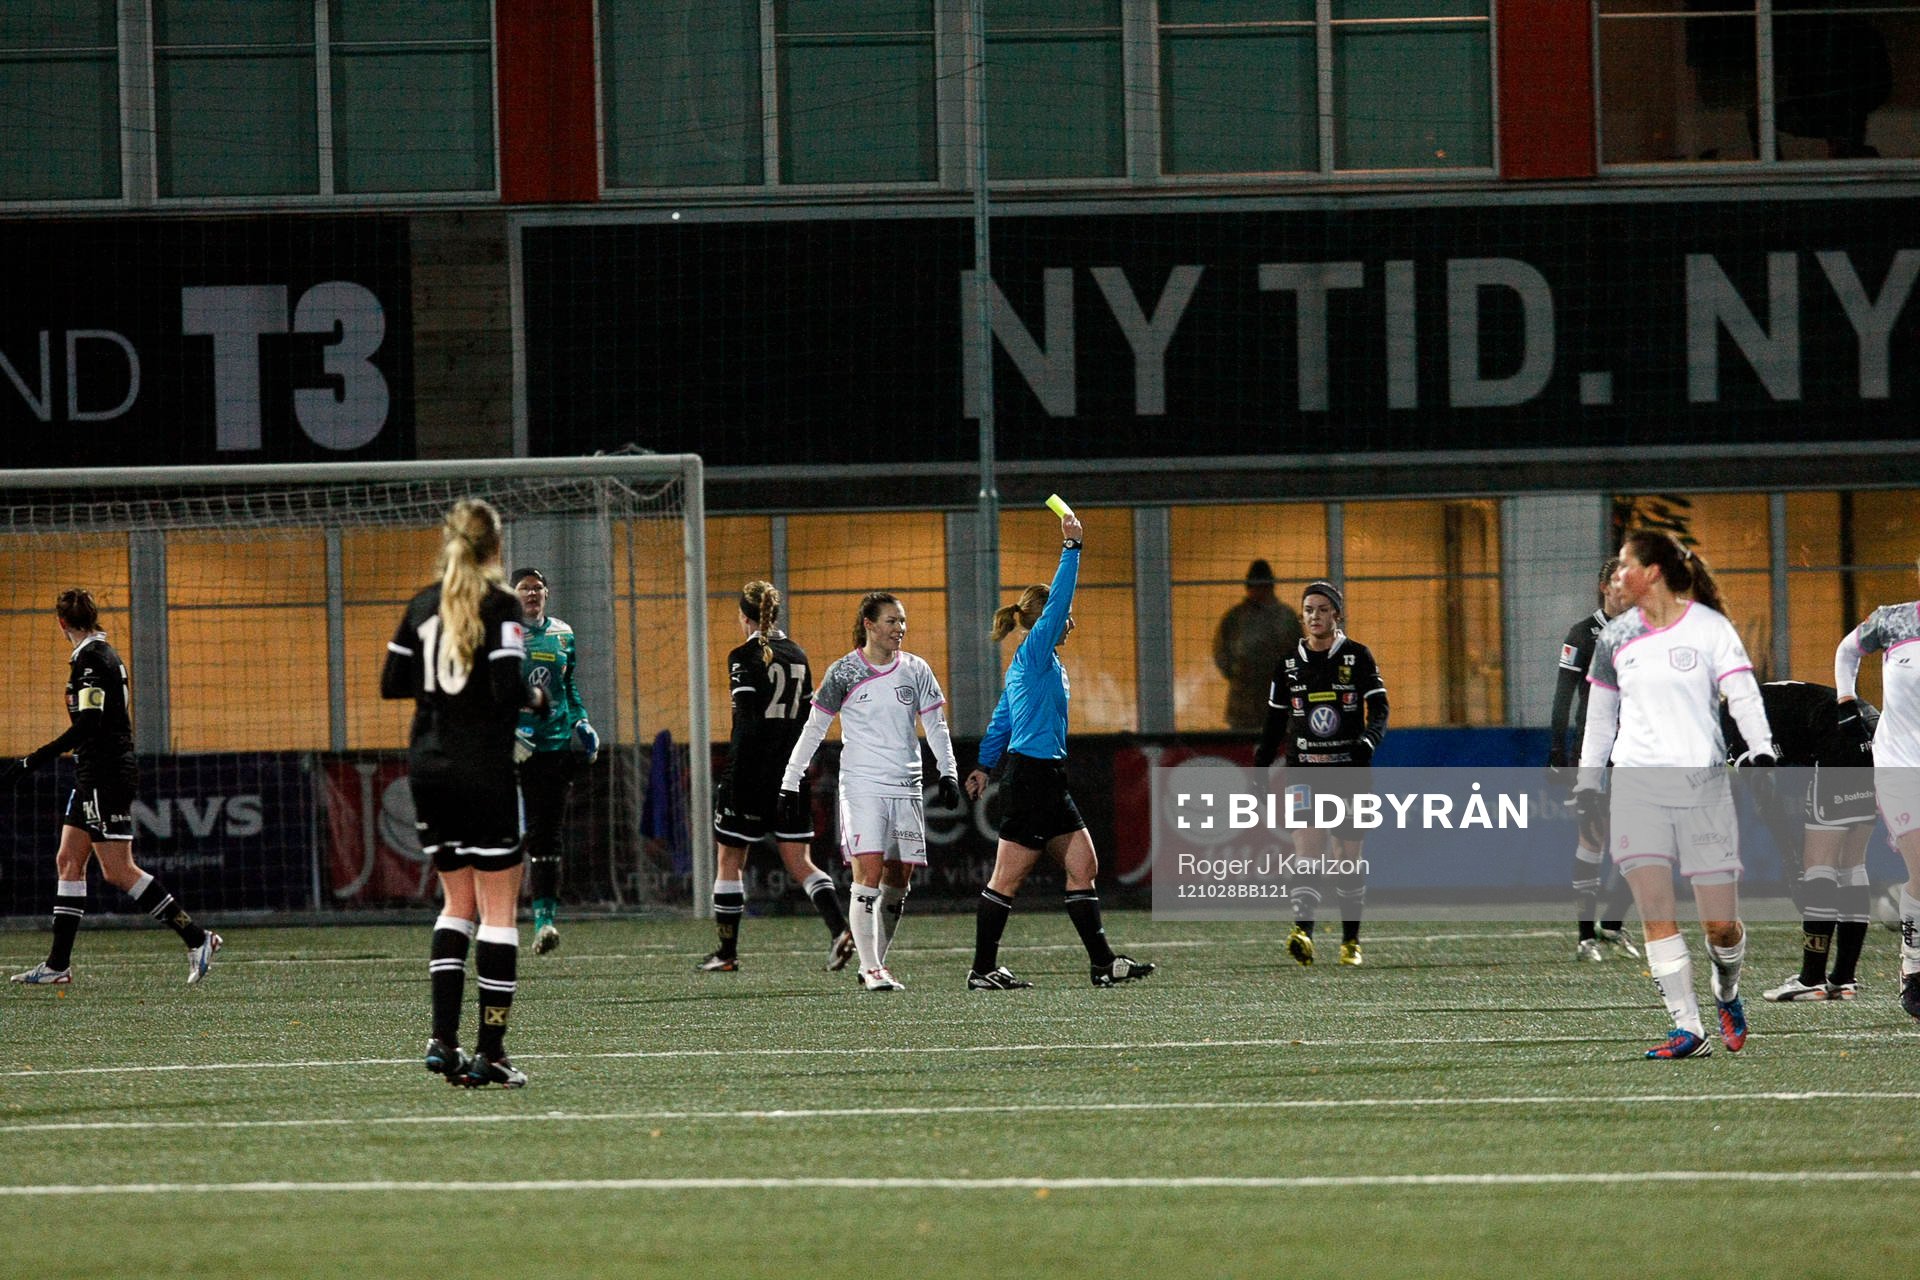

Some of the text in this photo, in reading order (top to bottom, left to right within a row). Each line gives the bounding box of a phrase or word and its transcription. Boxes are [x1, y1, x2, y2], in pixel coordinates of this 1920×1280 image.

[181, 281, 390, 451] T3
[961, 249, 1920, 418] NY TID. NY
[765, 662, 807, 719] 27
[131, 794, 263, 838] NVS
